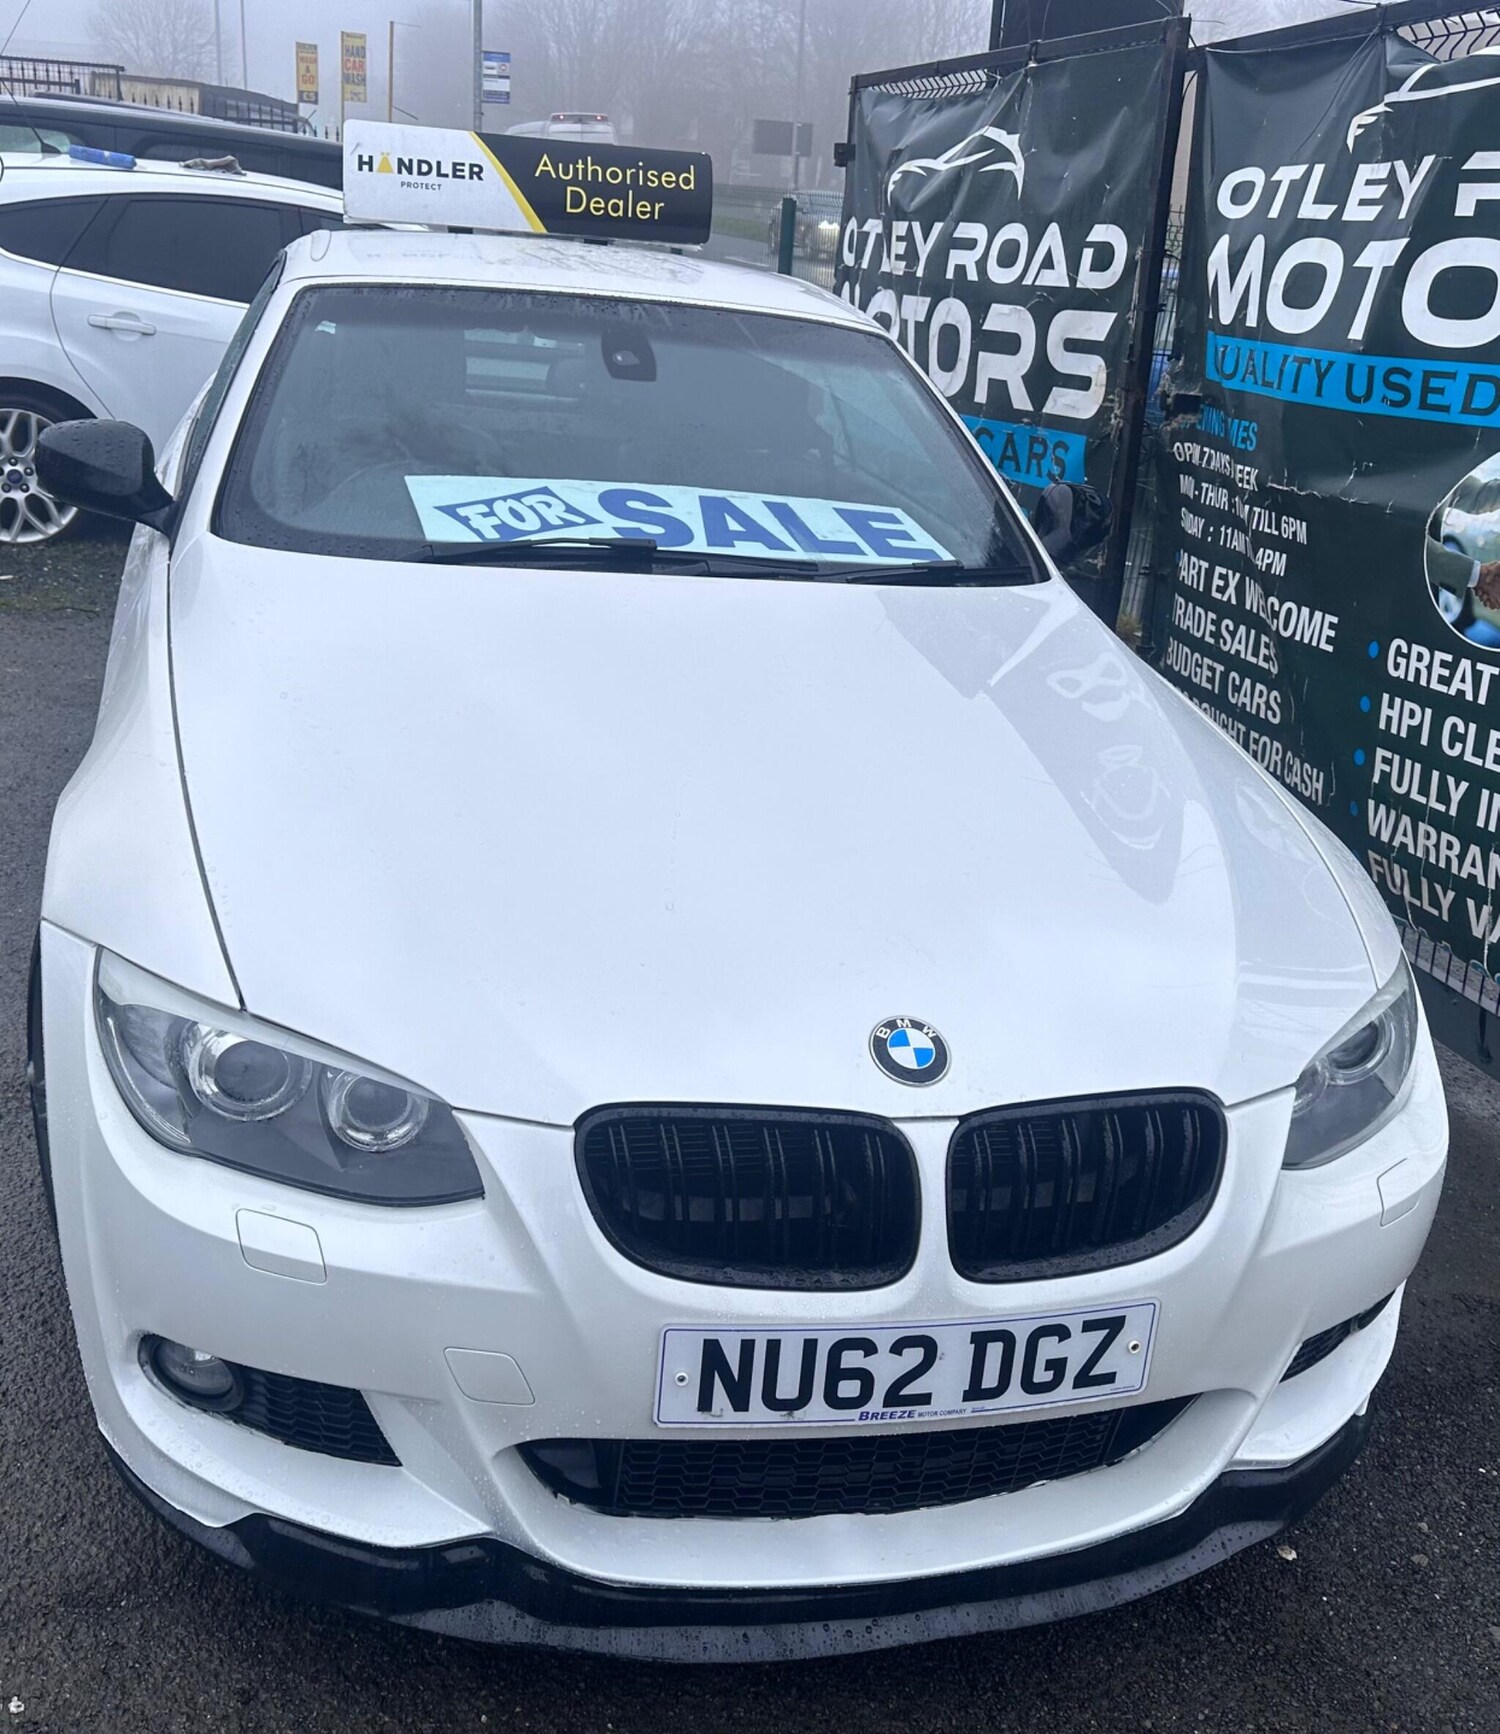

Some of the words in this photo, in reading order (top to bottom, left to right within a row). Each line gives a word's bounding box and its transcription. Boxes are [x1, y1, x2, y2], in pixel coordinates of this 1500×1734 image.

[302, 74, 315, 85] GO
[345, 58, 364, 73] CAR
[400, 181, 442, 191] PROTECT
[534, 154, 696, 191] Authorised
[1216, 154, 1437, 222] OTLEY
[565, 187, 665, 220] Dealer
[945, 221, 1128, 290] ROAD
[841, 281, 1118, 420] OTORS
[1214, 344, 1333, 398] UALITY
[1345, 362, 1500, 416] USED
[972, 426, 1069, 481] CARS
[1231, 459, 1259, 491] EEK
[456, 493, 586, 540] FOR
[598, 488, 938, 560] SALE
[1252, 506, 1280, 536] TILL
[1281, 515, 1307, 545] 6PM
[1255, 548, 1287, 577] 4PM
[1211, 565, 1241, 607] EX
[1245, 576, 1339, 653] WECOME
[1219, 618, 1279, 675] SALES
[1387, 638, 1499, 706] GREAT
[1228, 671, 1281, 725] CARS
[1379, 692, 1432, 746] HPI
[1249, 729, 1282, 777] FOR
[1283, 751, 1324, 806] CASH
[1372, 746, 1469, 817] FULLY
[1367, 849, 1456, 923] FULLY
[876, 1018, 937, 1039] BMW
[696, 1333, 939, 1412] NU62
[962, 1315, 1128, 1403] DGZ
[858, 1409, 917, 1421] BREEZE
[918, 1410, 938, 1418] MOTOR
[939, 1408, 967, 1416] COMPANY
